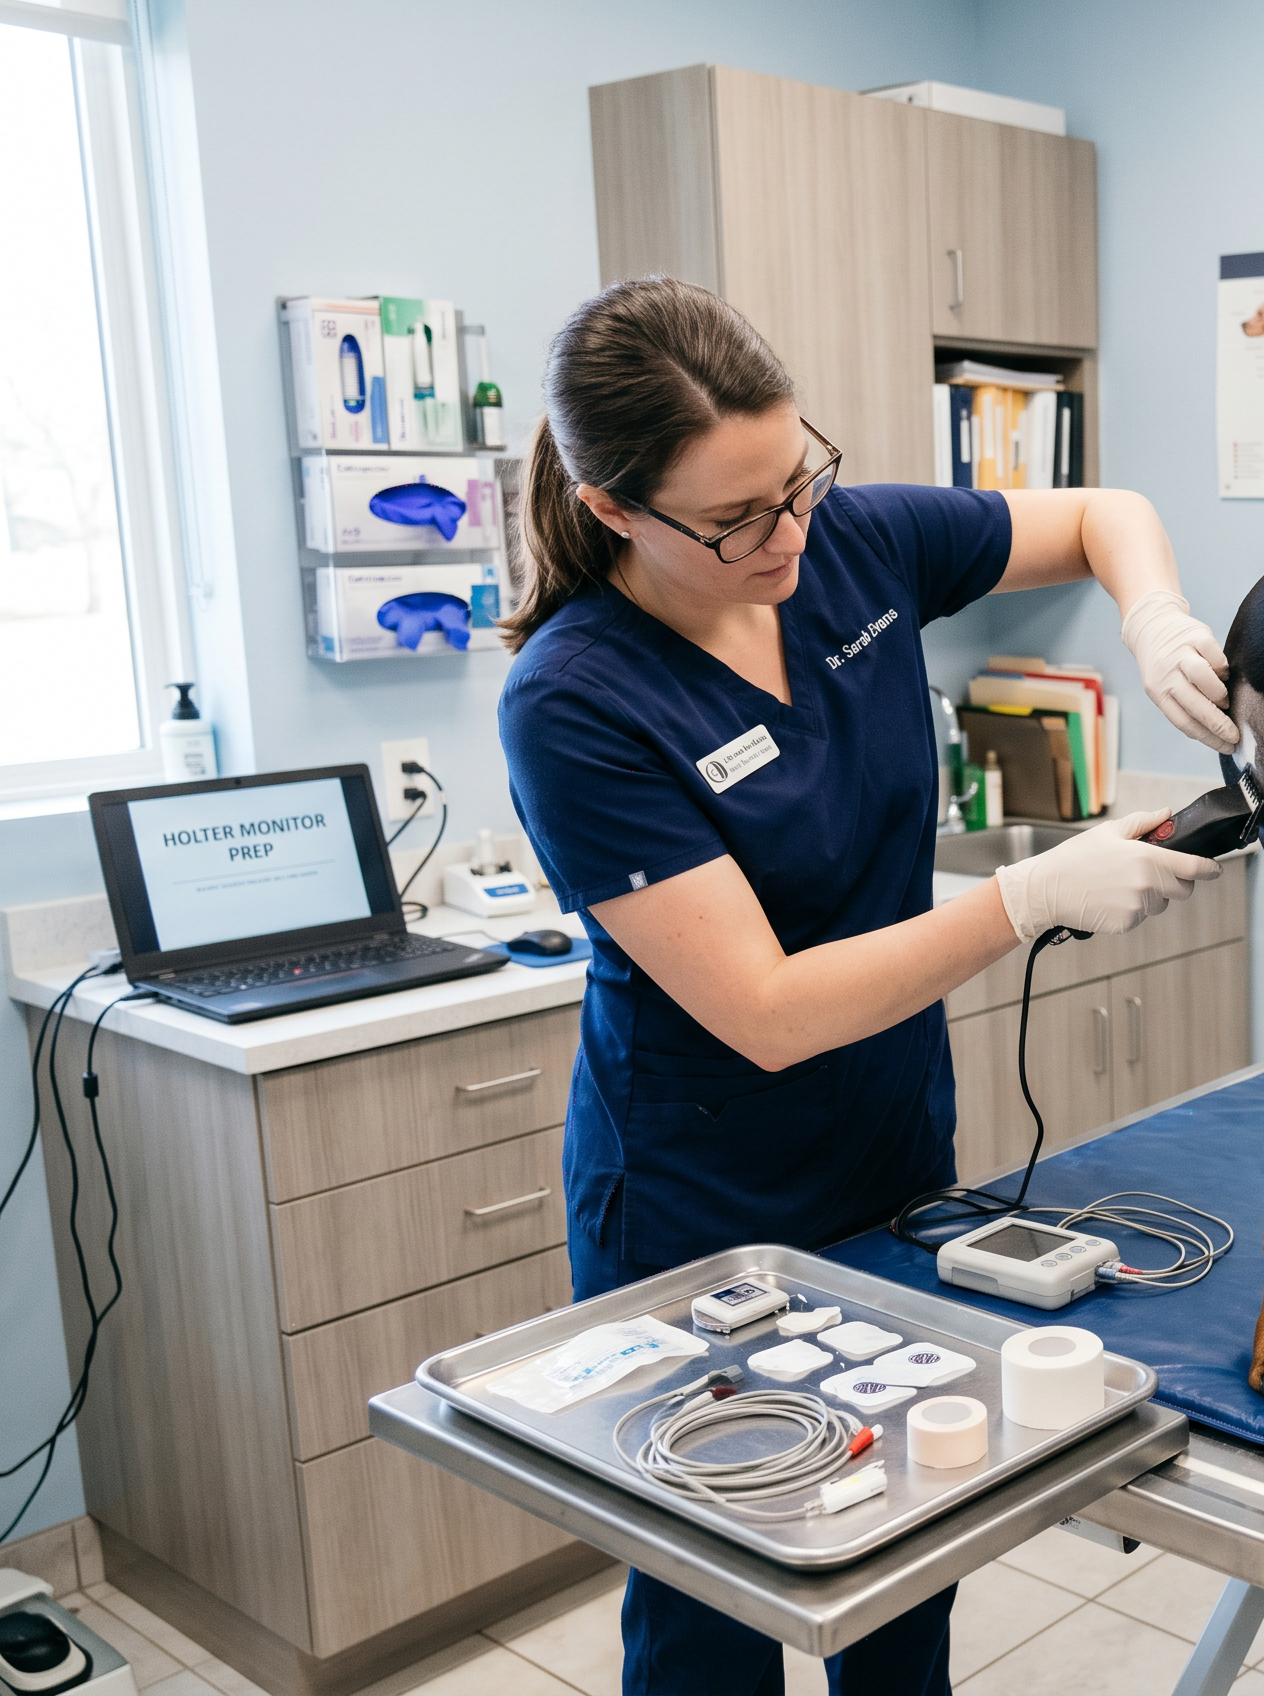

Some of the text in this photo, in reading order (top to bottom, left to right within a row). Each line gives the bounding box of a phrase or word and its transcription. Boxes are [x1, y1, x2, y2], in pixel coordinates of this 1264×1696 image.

[825, 655, 845, 670] Dr.
[867, 608, 898, 637] Evans
[162, 813, 327, 847] HOLTER MONITOR
[229, 842, 274, 862] PREP
